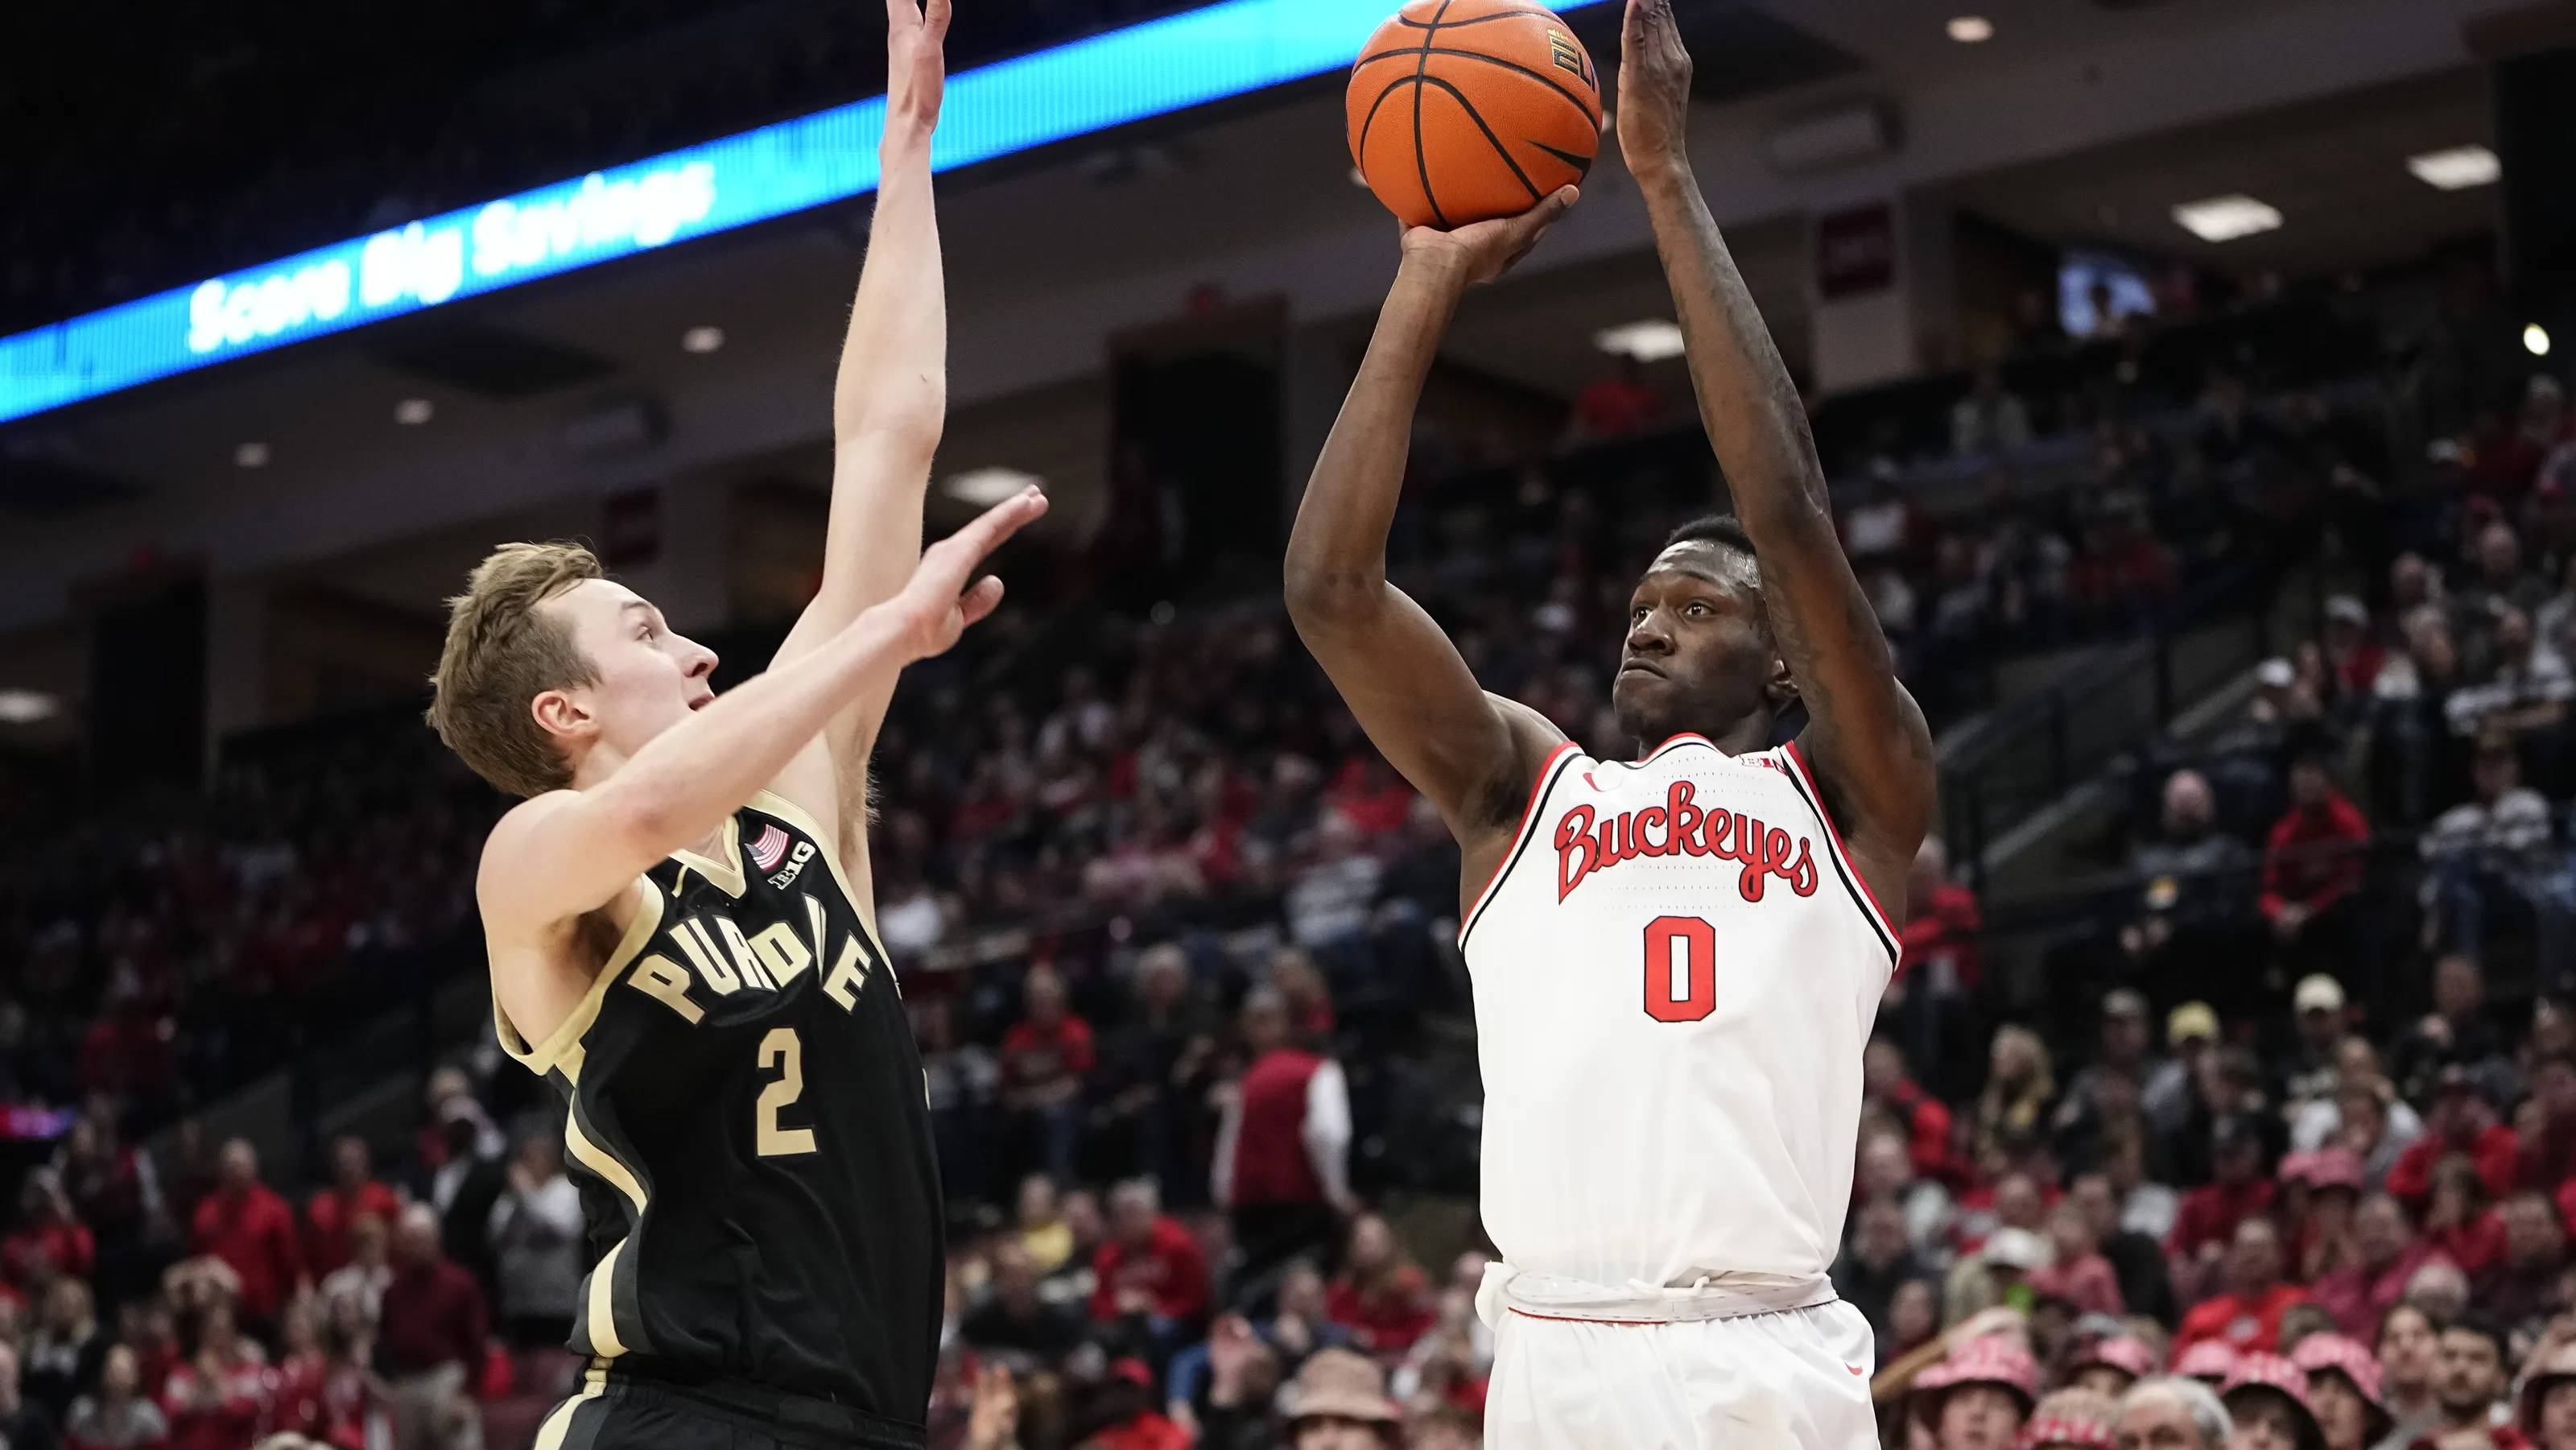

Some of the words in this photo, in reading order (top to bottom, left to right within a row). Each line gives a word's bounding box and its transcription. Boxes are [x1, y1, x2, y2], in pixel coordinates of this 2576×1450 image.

[187, 259, 350, 353] Score
[359, 221, 464, 305] Big
[472, 161, 716, 275] Savings
[1554, 780, 1818, 905] Buckeyes
[1644, 915, 1716, 1022] 0
[756, 1027, 818, 1157] 2
